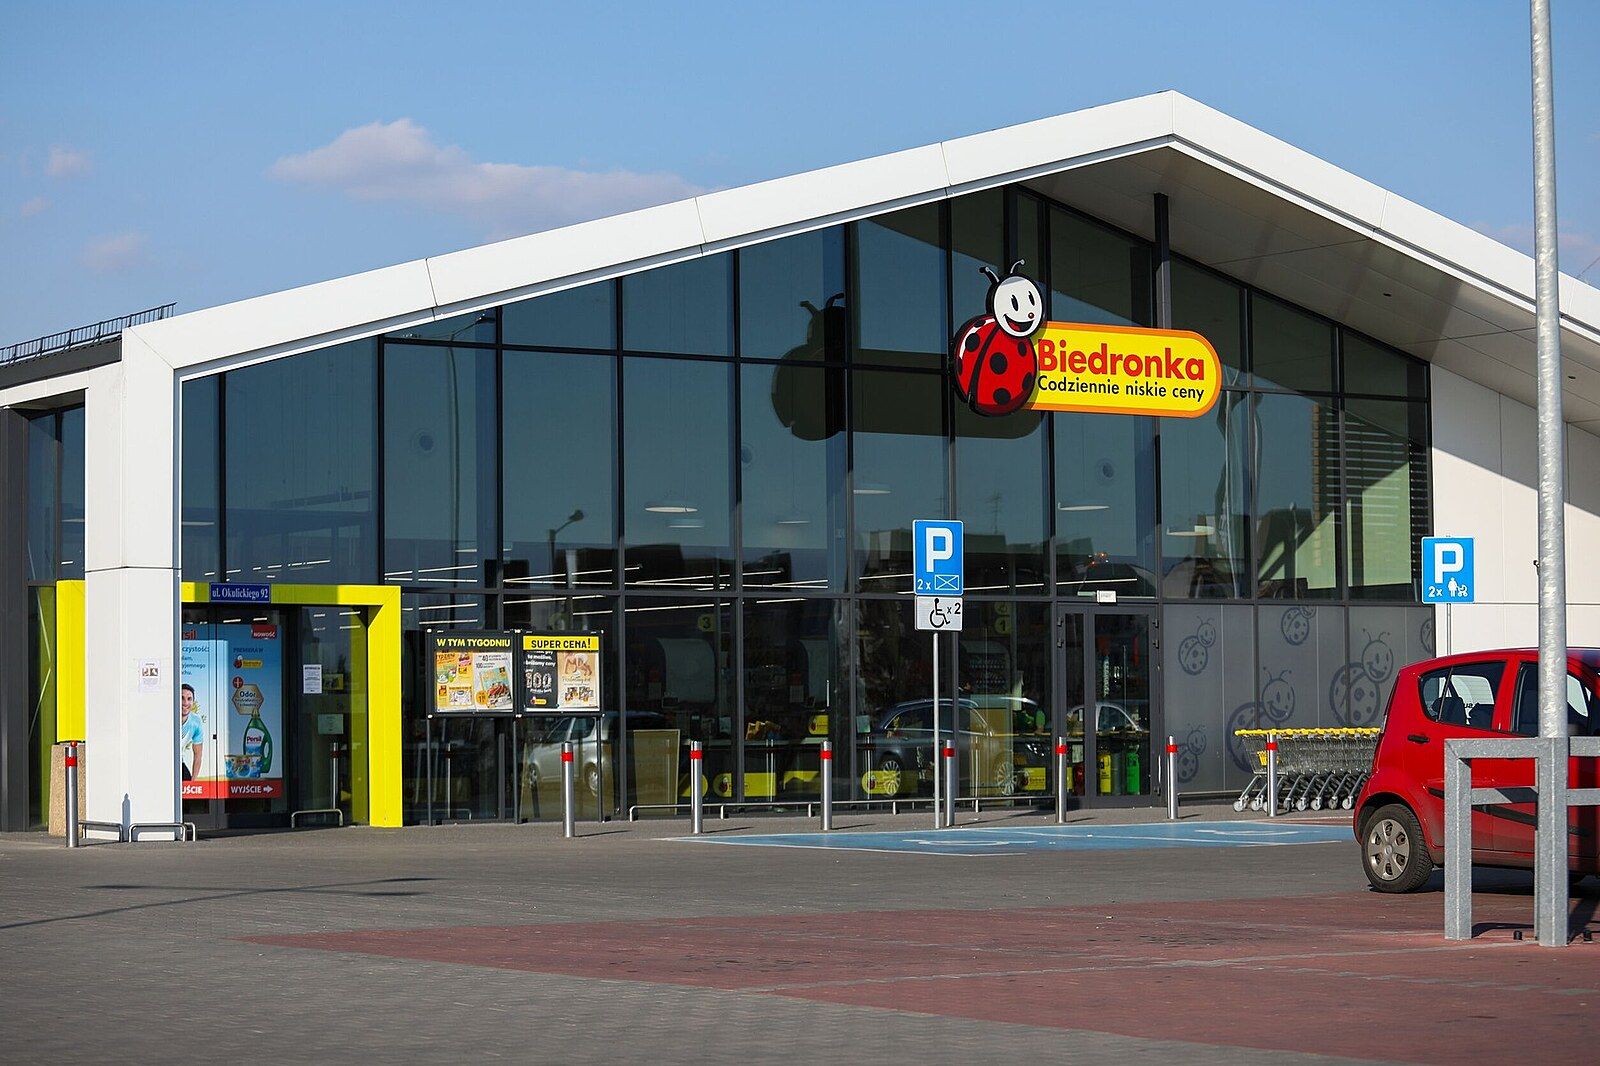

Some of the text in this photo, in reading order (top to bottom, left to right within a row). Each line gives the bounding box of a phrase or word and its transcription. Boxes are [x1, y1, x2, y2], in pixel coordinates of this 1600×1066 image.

[1037, 338, 1205, 381] Biedronka
[1037, 375, 1205, 402] Codziennie niskie ceny
[926, 527, 953, 573] P
[1434, 542, 1464, 584] P
[917, 579, 924, 590] 2
[212, 587, 268, 600] ul. Okulickiego 92
[954, 602, 961, 615] 2
[436, 638, 511, 647] W TYM TYGODNIU
[531, 638, 591, 649] SUPER CENA!
[230, 785, 262, 794] WYJŚCIE
